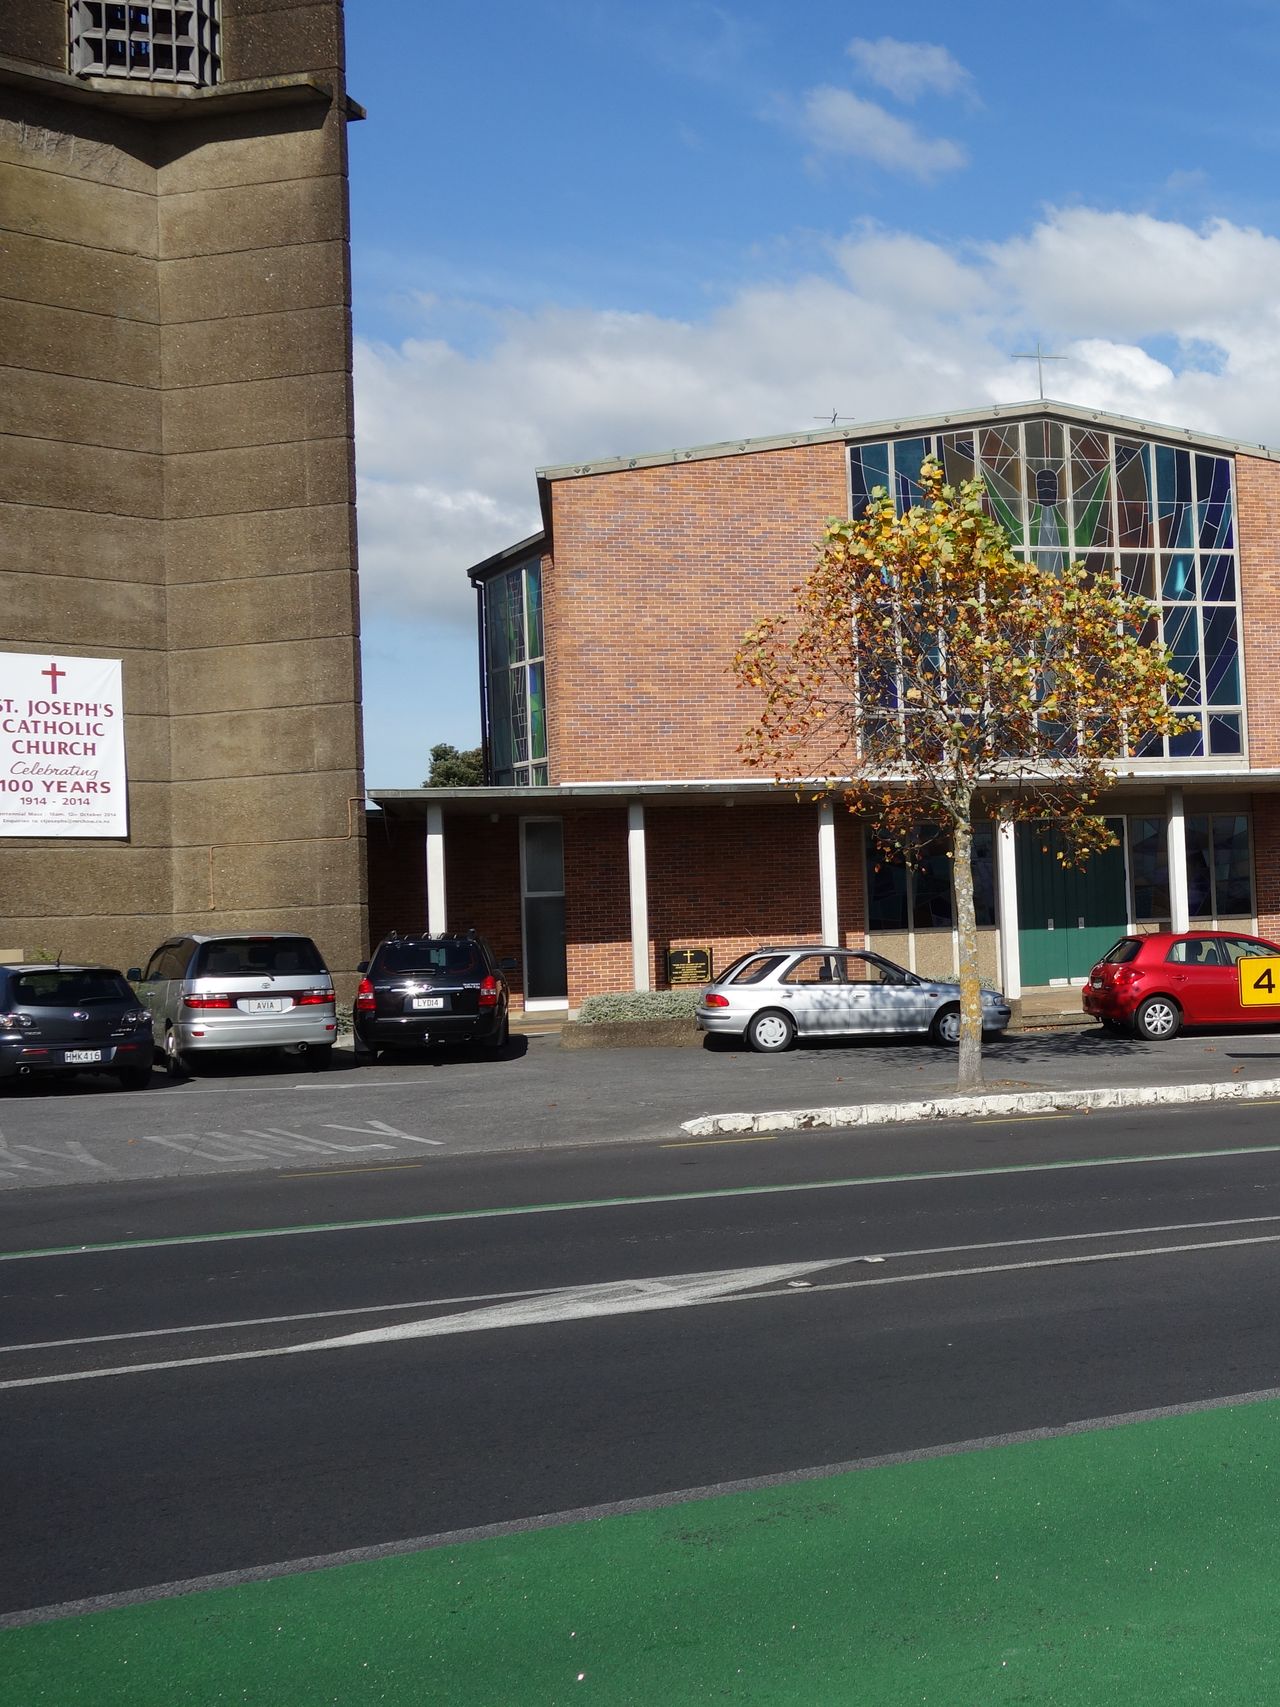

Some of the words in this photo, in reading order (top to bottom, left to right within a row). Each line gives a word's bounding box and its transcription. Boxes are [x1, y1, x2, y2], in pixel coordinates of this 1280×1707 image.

[28, 700, 114, 718] JOSEPH'S
[2, 719, 105, 737] CATHOLIC
[12, 740, 96, 756] CHURCH
[10, 761, 98, 780] Celebrating
[0, 780, 33, 793] 100
[42, 781, 111, 794] YEARS
[20, 797, 47, 806] 1914
[62, 797, 90, 806] 2014
[256, 1001, 275, 1009] AVIA
[65, 1051, 101, 1061] HMK416
[143, 1120, 446, 1162] ONLY
